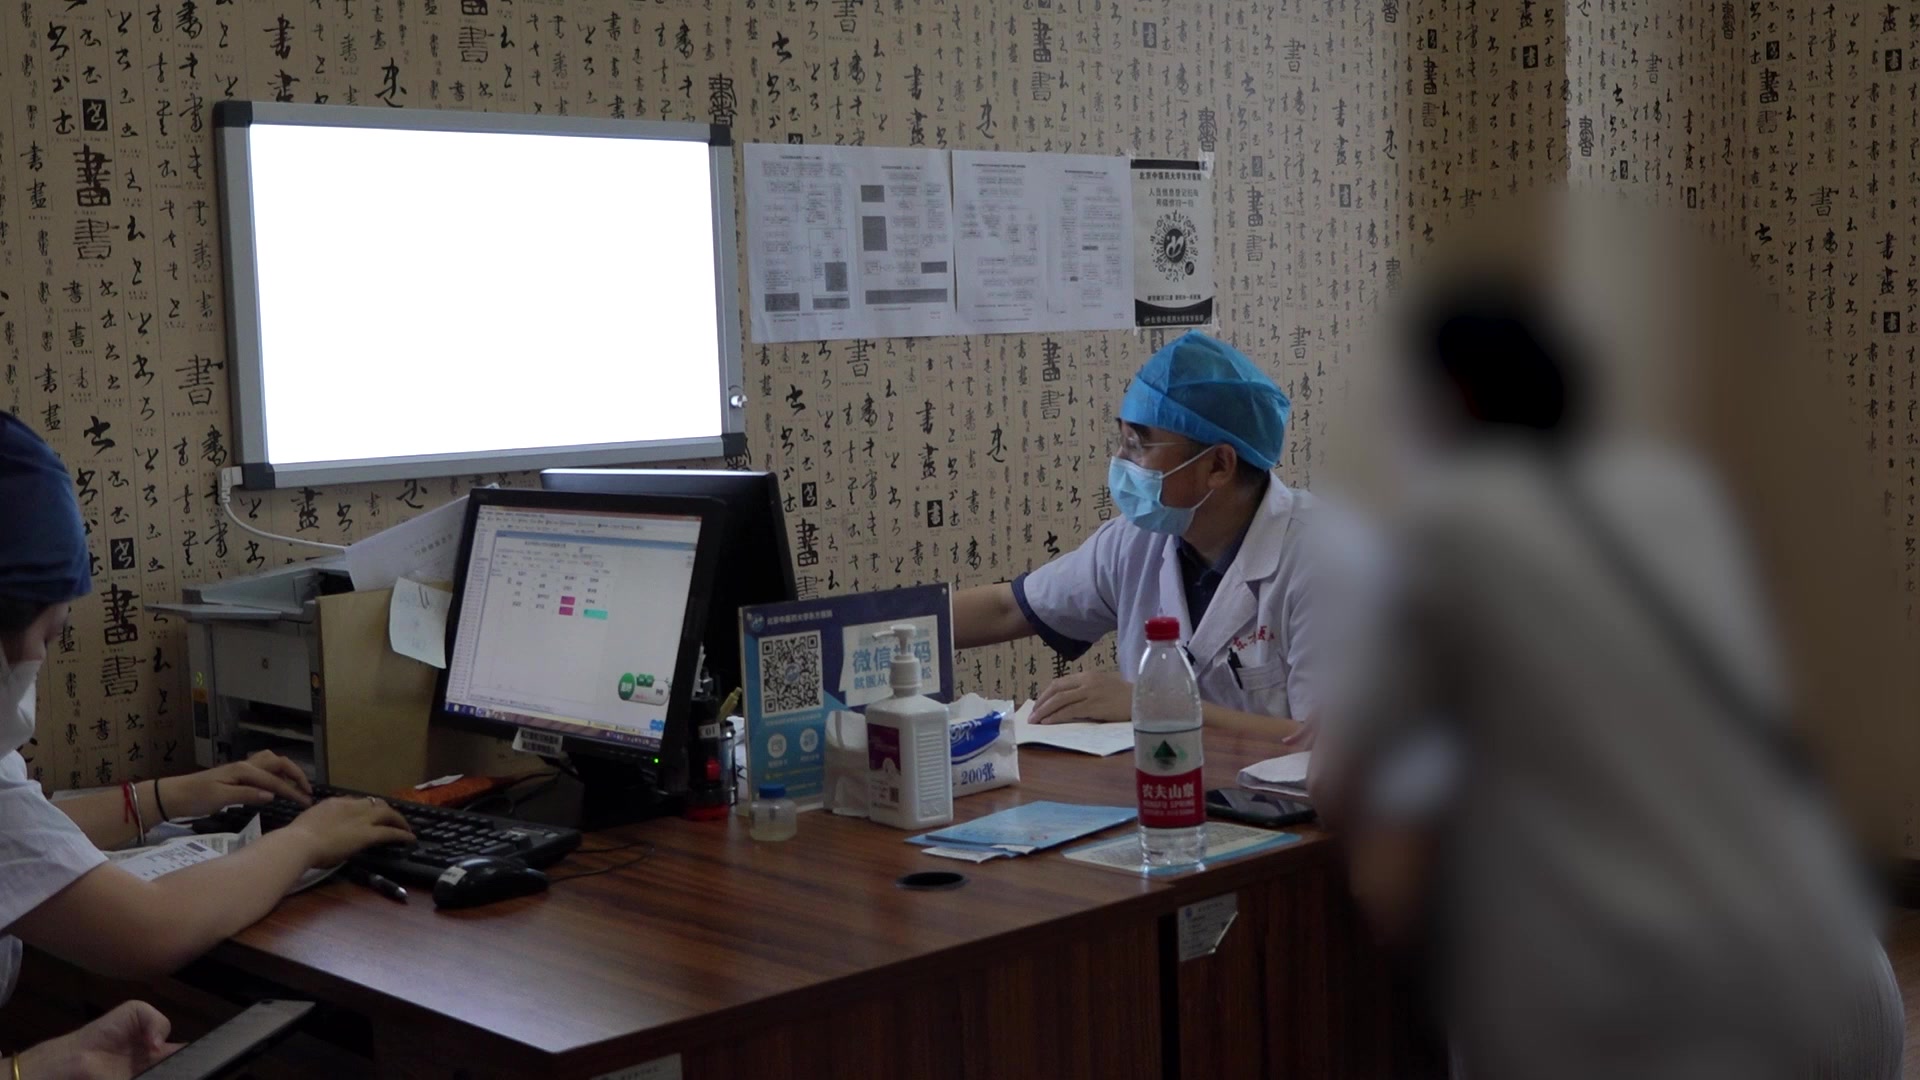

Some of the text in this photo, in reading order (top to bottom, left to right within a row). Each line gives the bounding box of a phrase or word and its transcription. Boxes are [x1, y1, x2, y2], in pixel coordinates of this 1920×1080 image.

[854, 667, 932, 690] 就医从松
[961, 762, 996, 786] 200张
[1142, 782, 1195, 799] 农夫山泉
